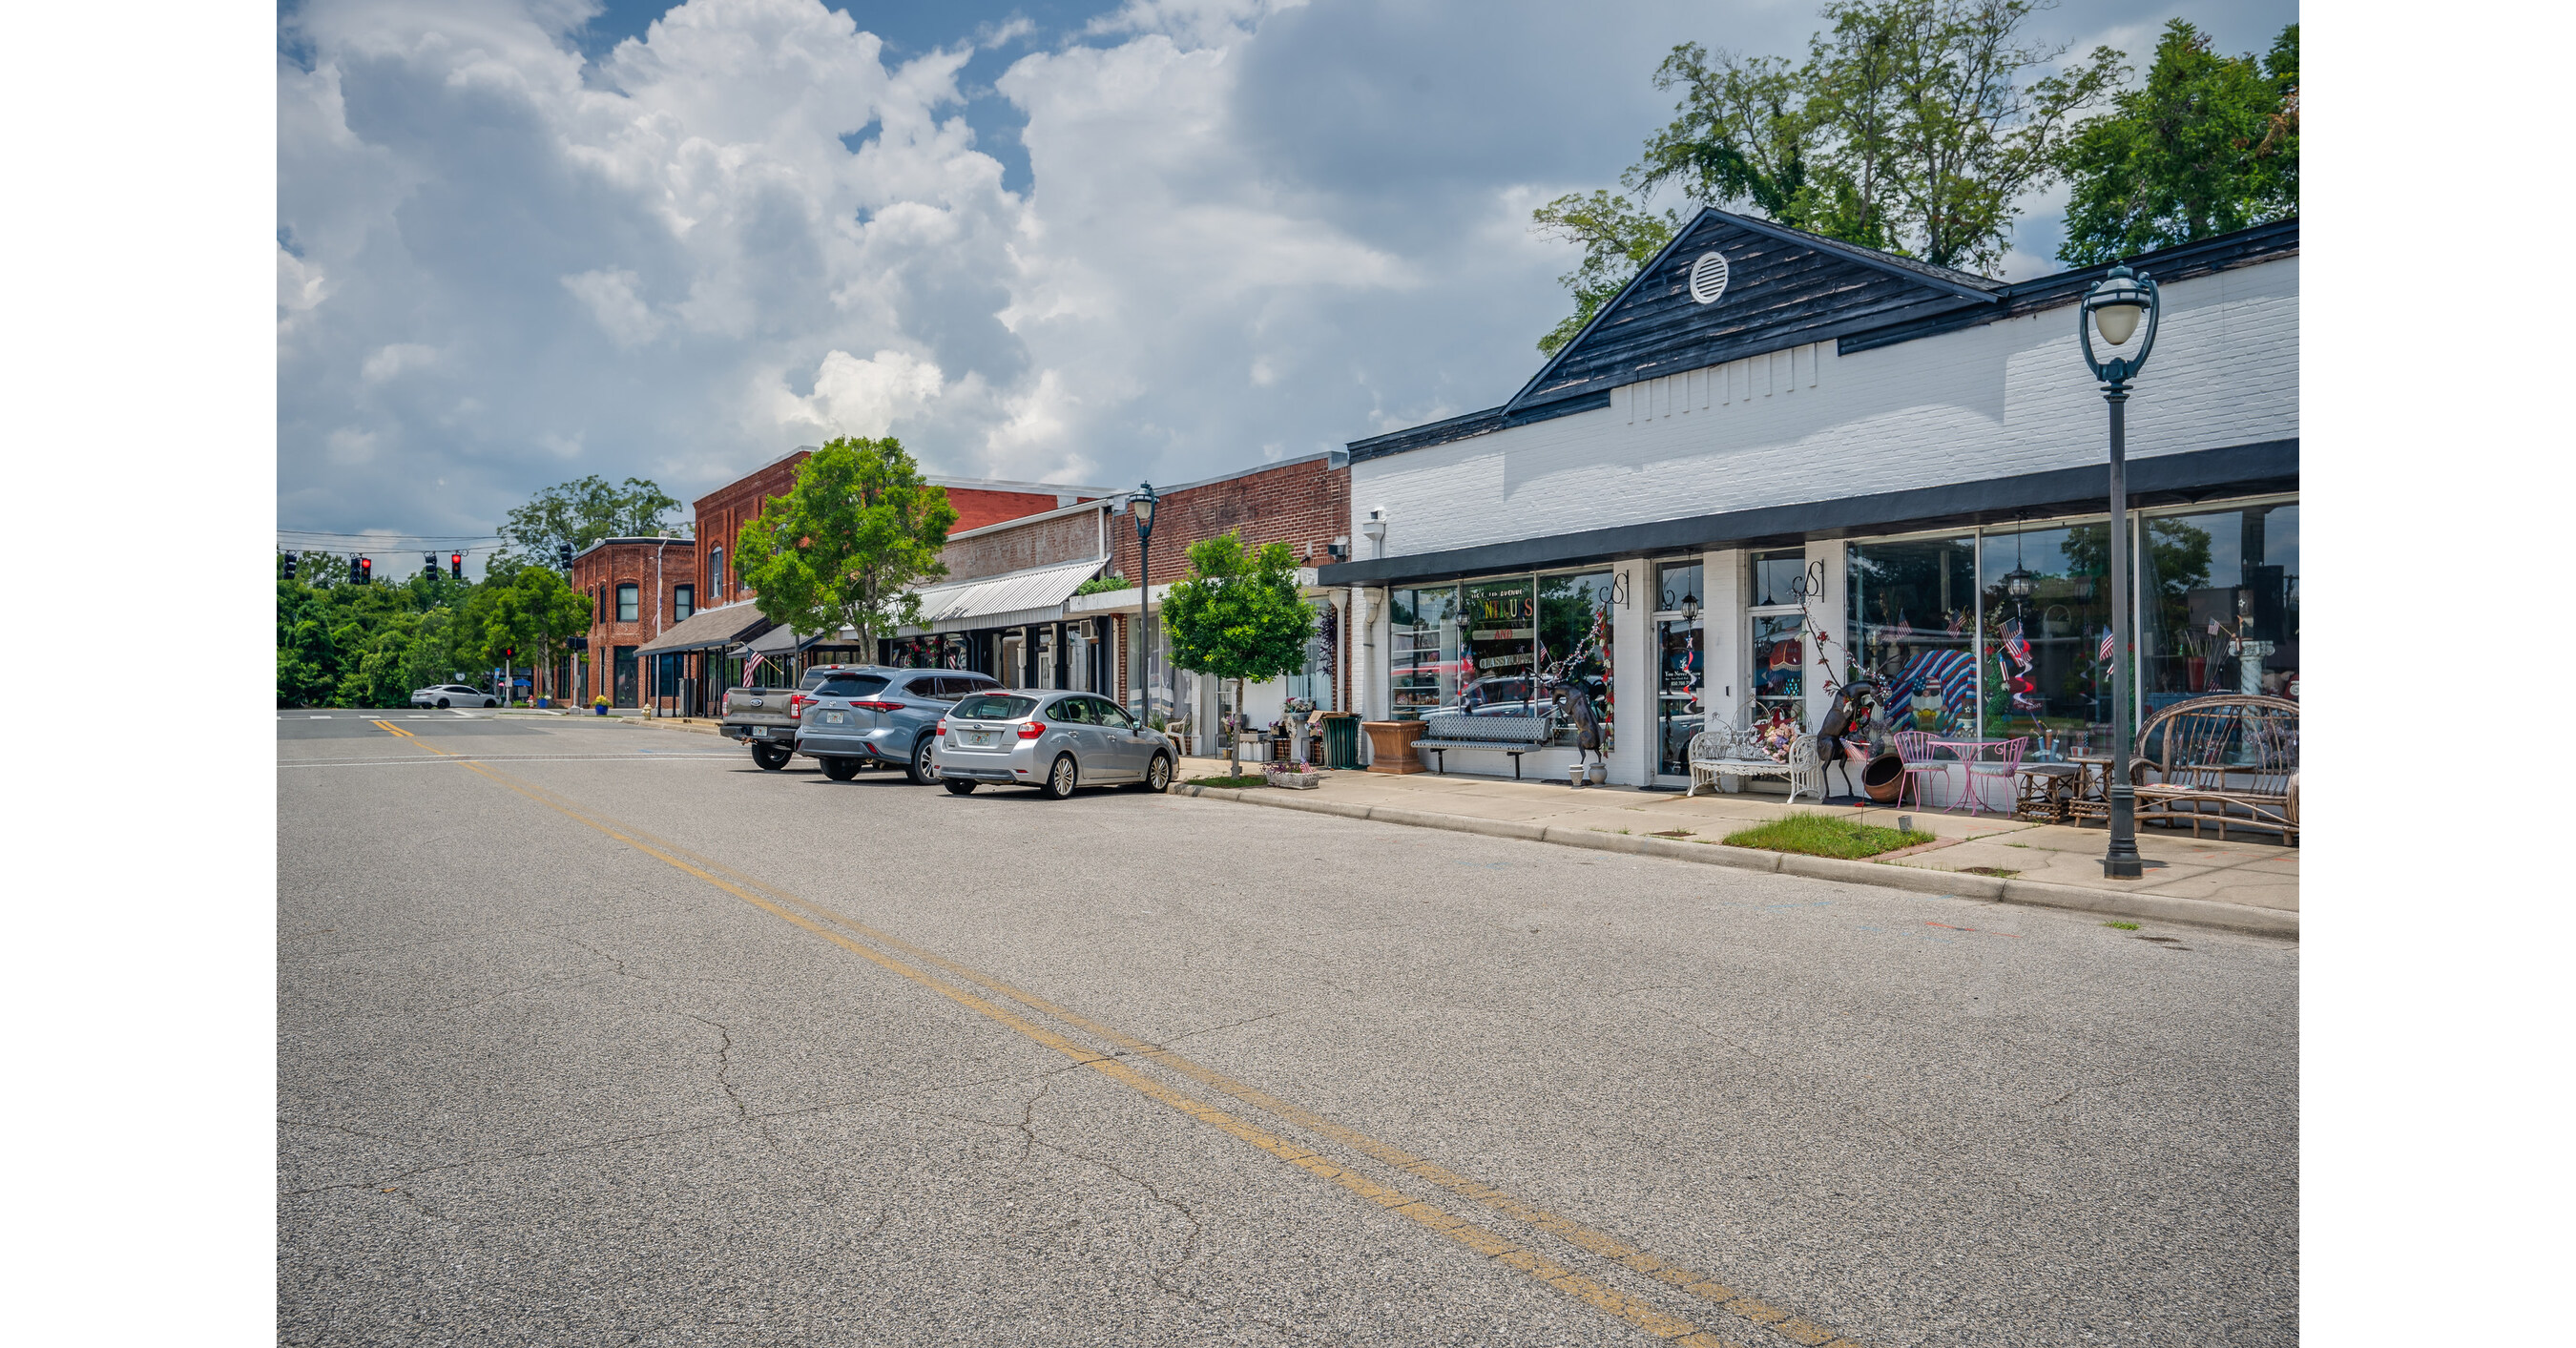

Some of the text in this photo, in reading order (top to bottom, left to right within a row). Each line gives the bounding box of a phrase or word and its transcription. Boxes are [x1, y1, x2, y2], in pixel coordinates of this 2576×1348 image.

[1478, 597, 1533, 619] ANTIQUES
[1494, 629, 1513, 640] AND
[1479, 656, 1509, 669] CLASSY
